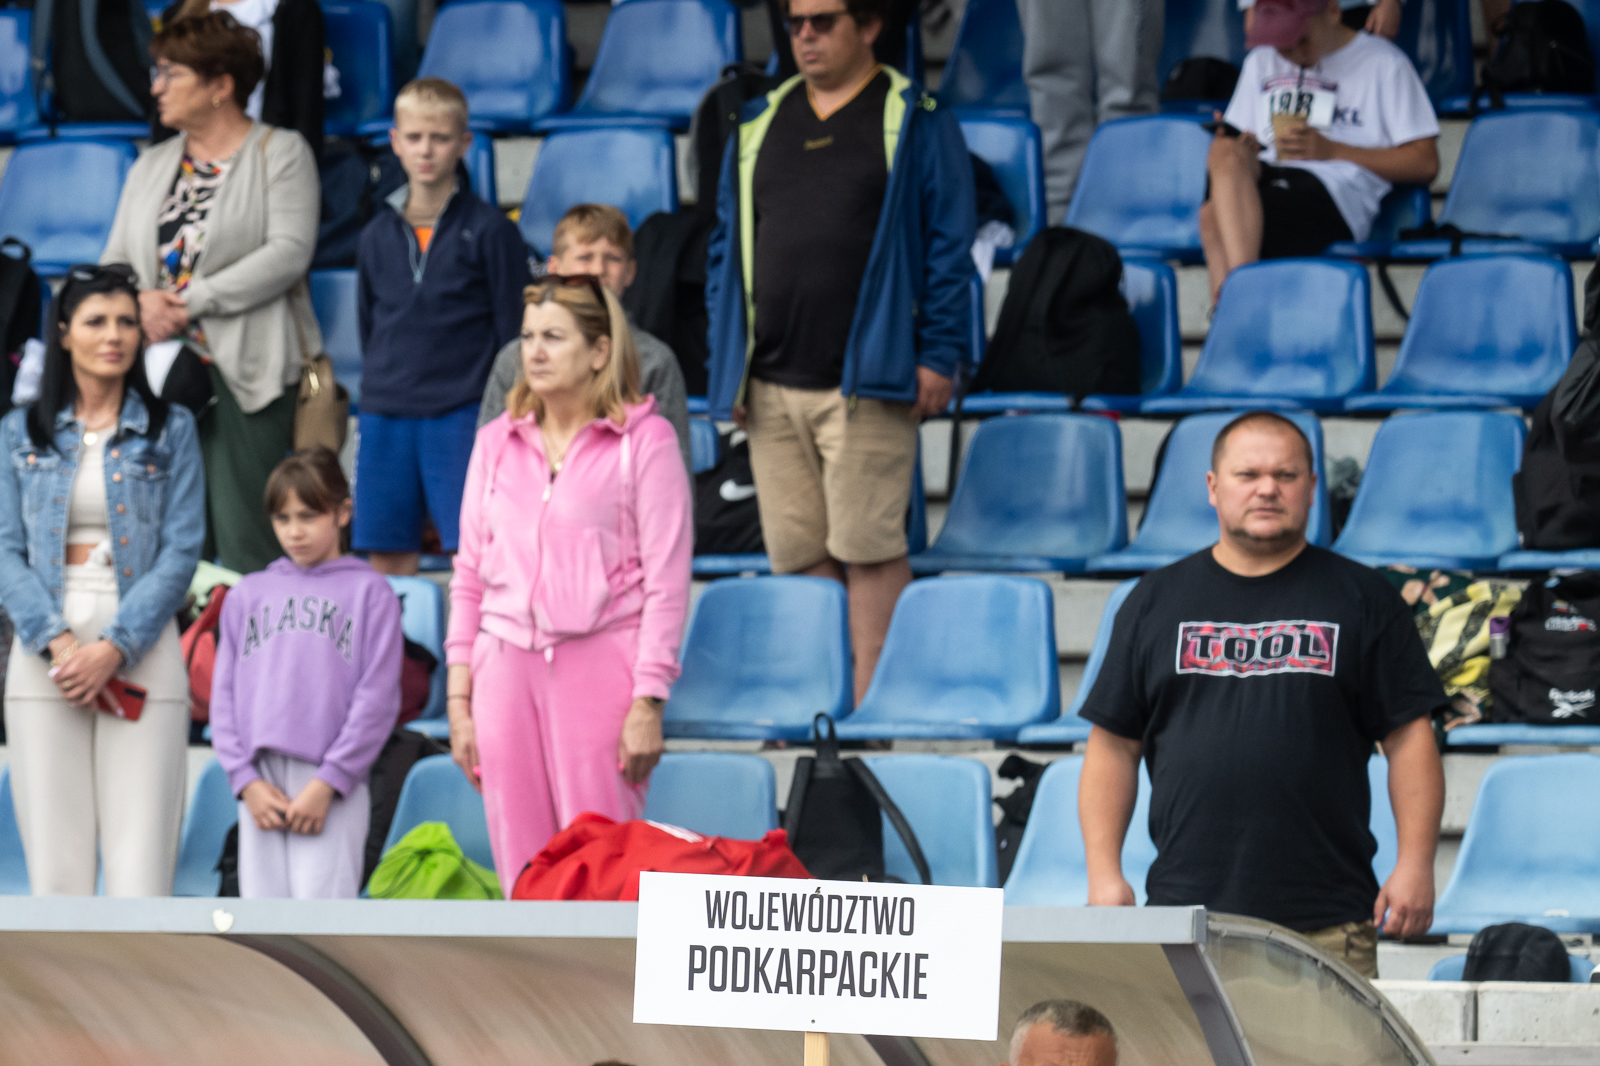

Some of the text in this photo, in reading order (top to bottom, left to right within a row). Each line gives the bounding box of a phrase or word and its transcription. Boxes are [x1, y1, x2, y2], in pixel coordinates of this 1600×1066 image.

[242, 596, 354, 664] ALASKA
[1187, 630, 1330, 665] TOOL
[705, 887, 916, 936] WOJEWÓDZTWO
[687, 944, 929, 1000] PODKARPACKIE
